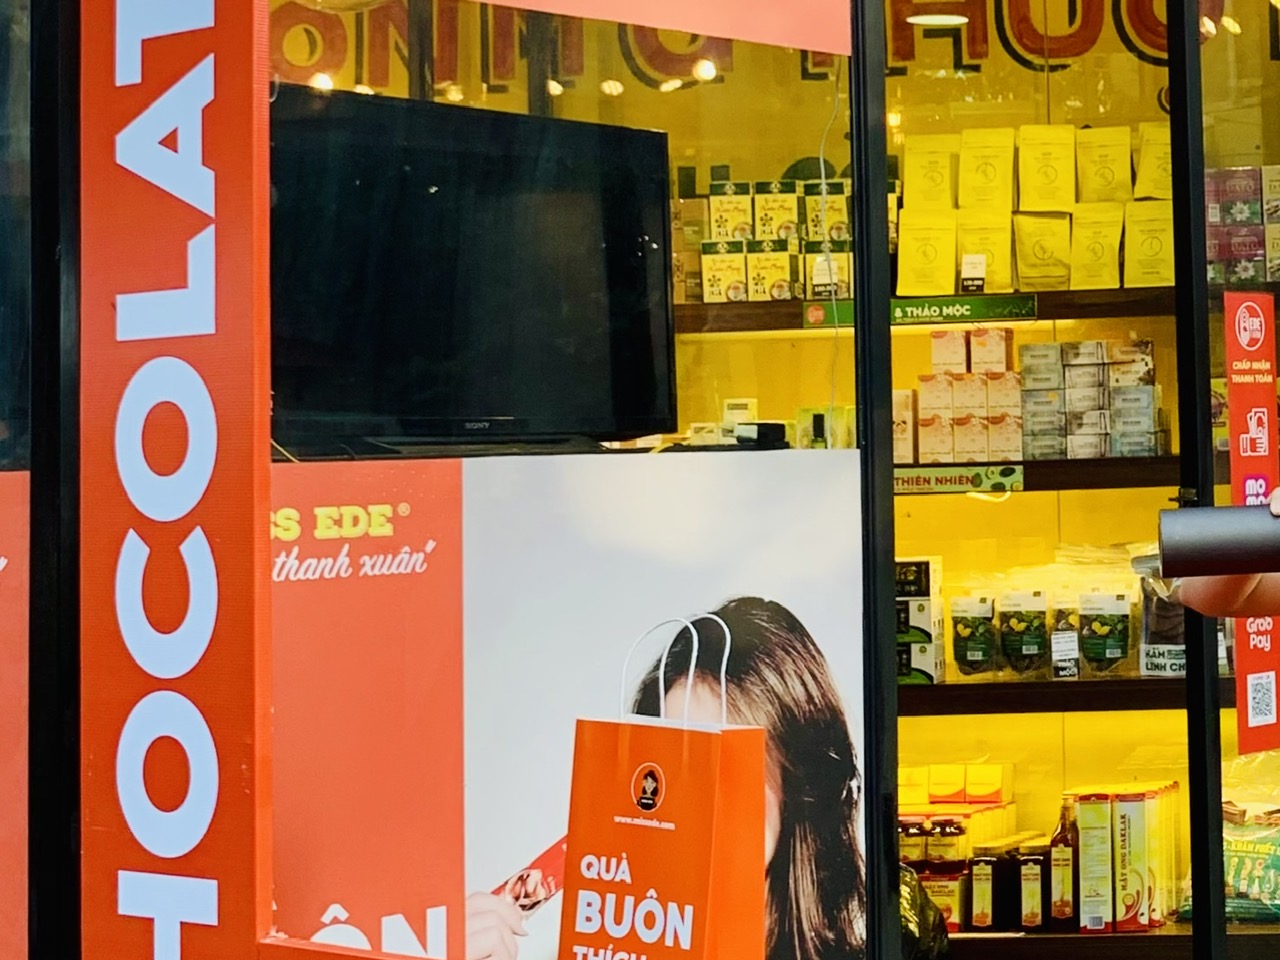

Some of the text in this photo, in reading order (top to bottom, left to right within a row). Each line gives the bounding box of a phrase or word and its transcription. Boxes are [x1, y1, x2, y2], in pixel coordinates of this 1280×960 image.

[942, 303, 972, 319] MỘC
[271, 507, 301, 542] S
[272, 543, 353, 582] thanh
[1249, 633, 1271, 652] Pay
[580, 852, 632, 885] QUÀ
[574, 888, 694, 951] BUÔN
